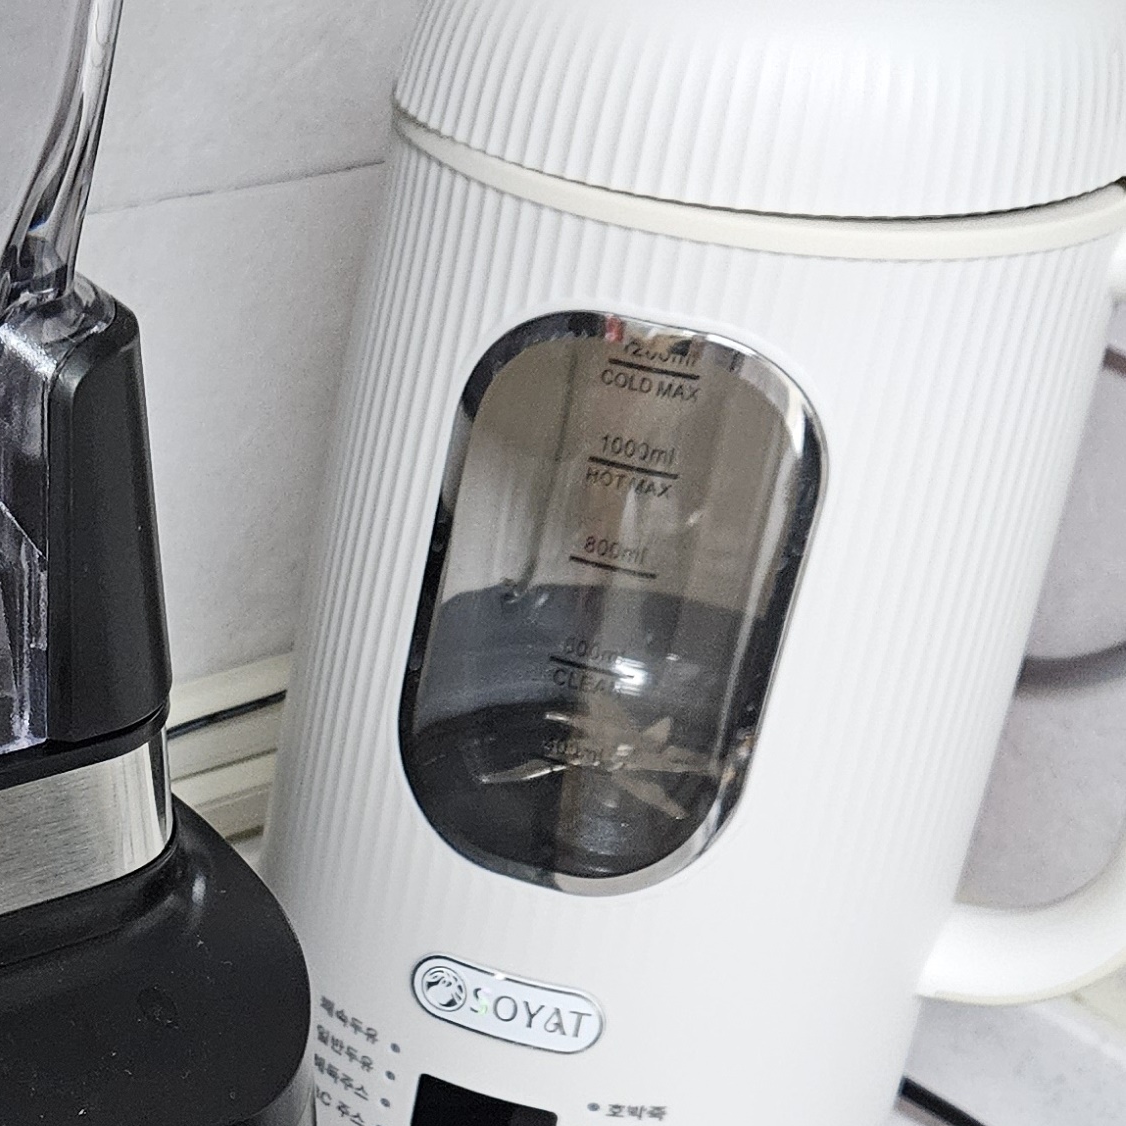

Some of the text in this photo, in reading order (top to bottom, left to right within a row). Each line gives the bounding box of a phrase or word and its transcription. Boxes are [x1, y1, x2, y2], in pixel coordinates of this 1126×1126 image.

[601, 368, 701, 402] COLD MAX
[601, 434, 676, 466] 1000ml
[585, 466, 672, 499] HOT MAX
[470, 987, 593, 1039] SOYAT
